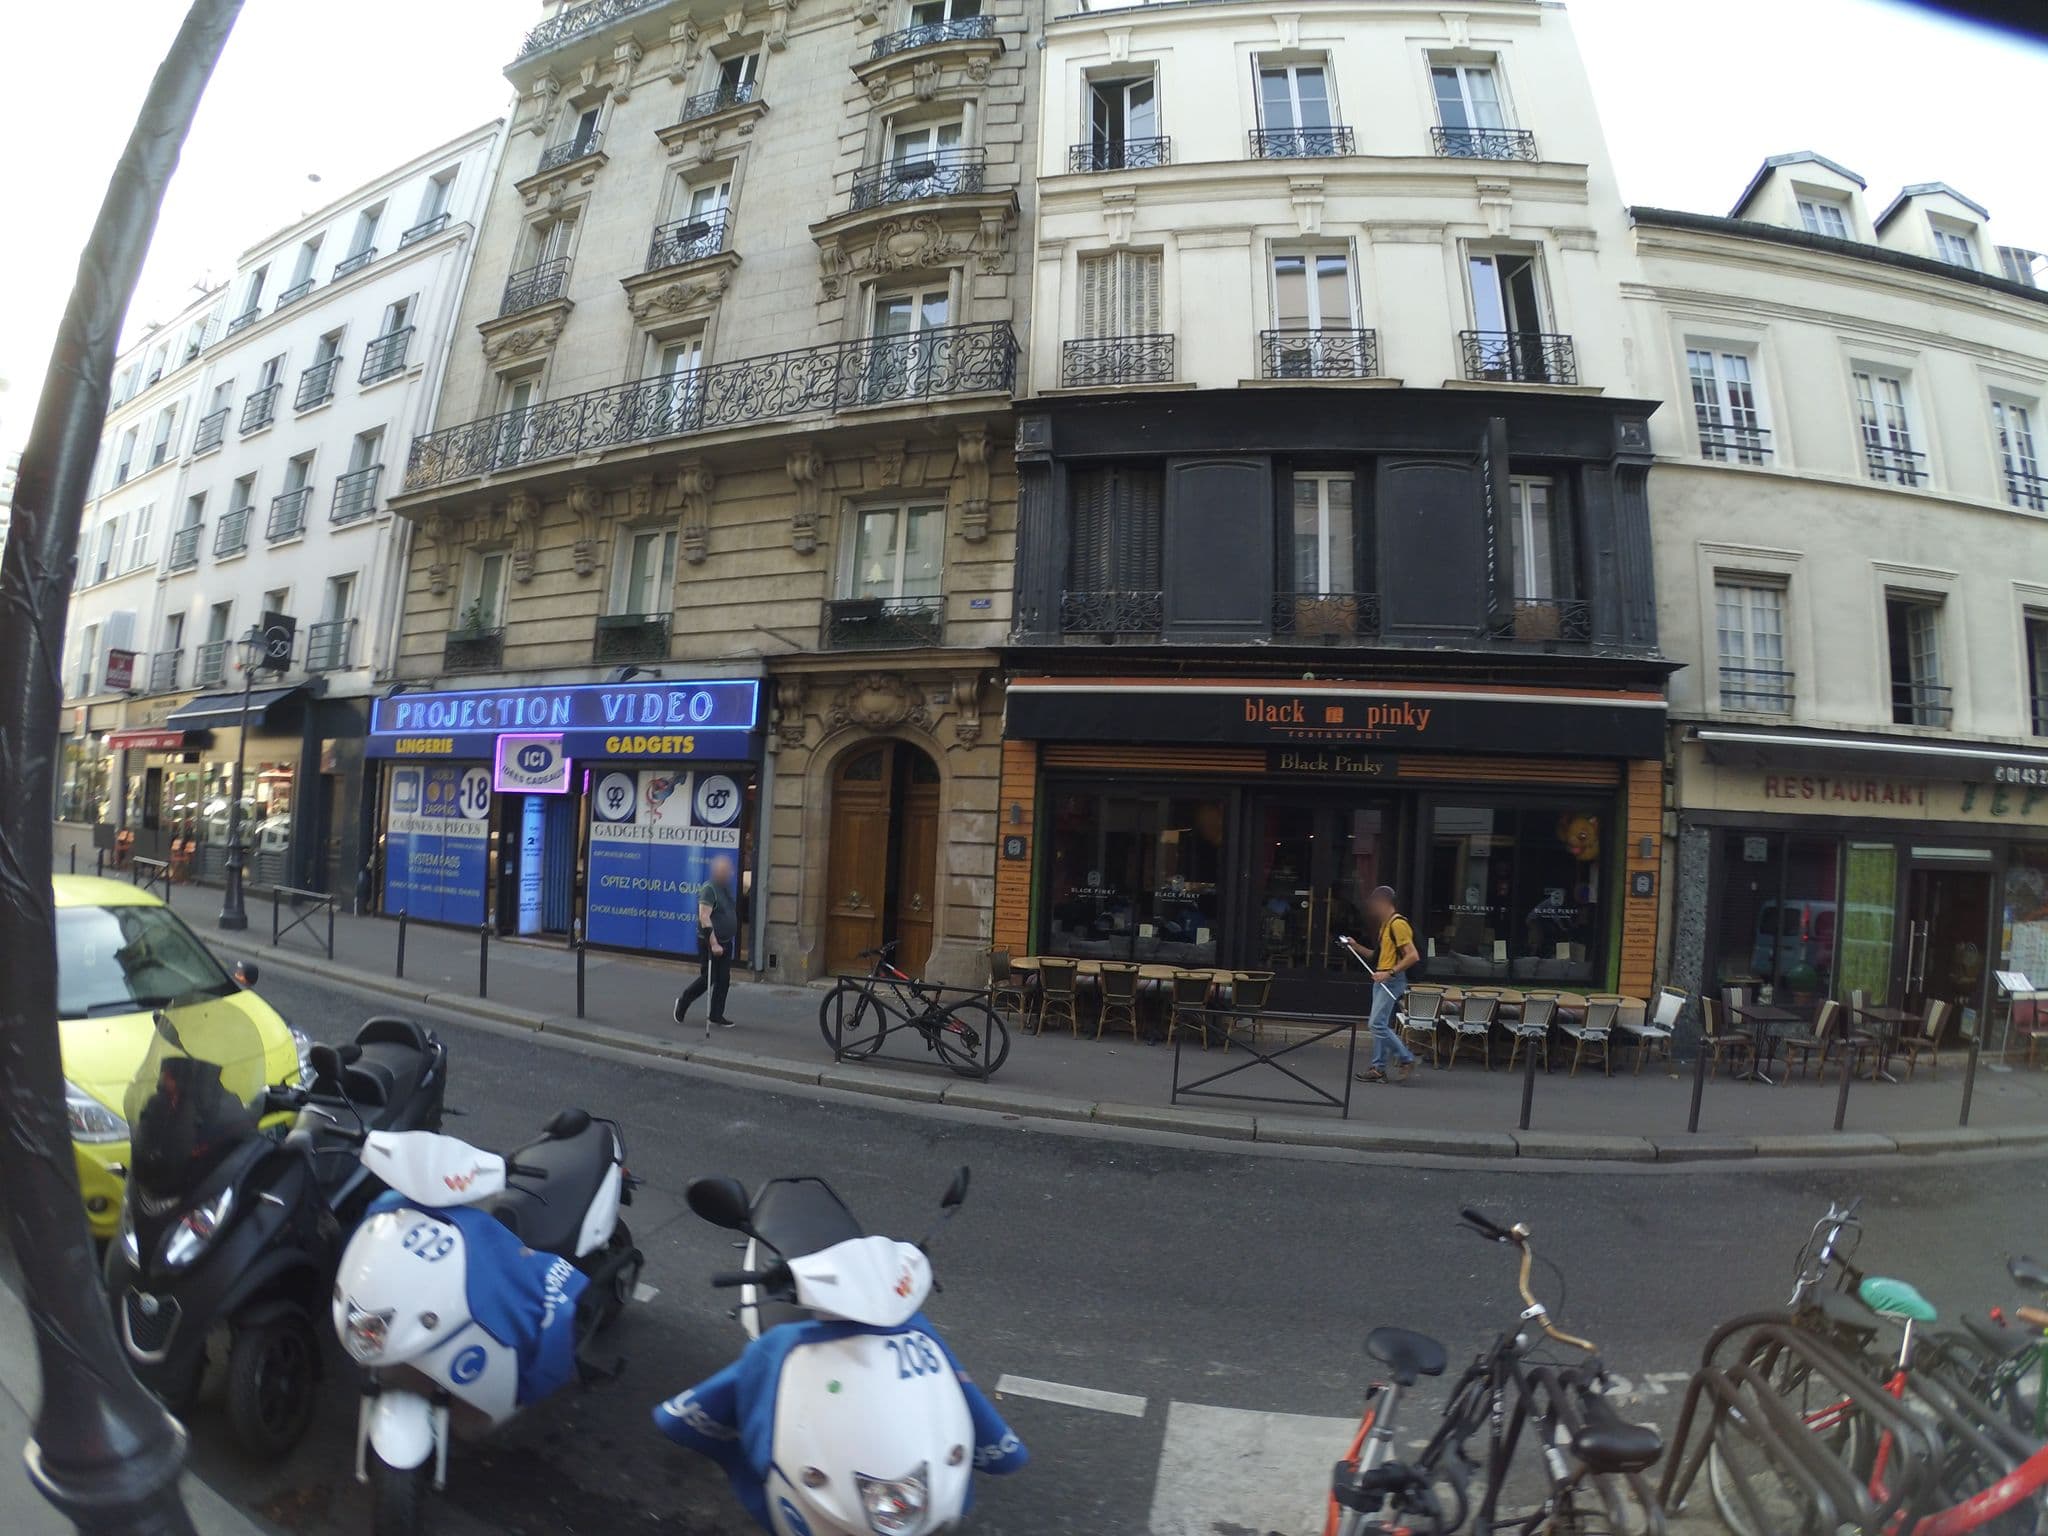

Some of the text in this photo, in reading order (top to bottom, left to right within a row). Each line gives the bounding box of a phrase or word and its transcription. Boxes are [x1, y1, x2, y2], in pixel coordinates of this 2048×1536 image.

[396, 691, 713, 729] PROJECTION VIDEO
[1245, 699, 1432, 731] black pinky
[1288, 730, 1382, 740] restaurant
[396, 737, 454, 754] LINGERIE
[605, 736, 695, 753] GADGETS
[523, 751, 545, 767] ICI
[1280, 753, 1384, 775] Black Pinky
[1765, 775, 1924, 806] RESTAURANT
[594, 824, 736, 843] GADGETS EROTIQUES
[600, 875, 631, 889] OPTEZ
[632, 877, 661, 891] POUR
[663, 880, 677, 892] LA
